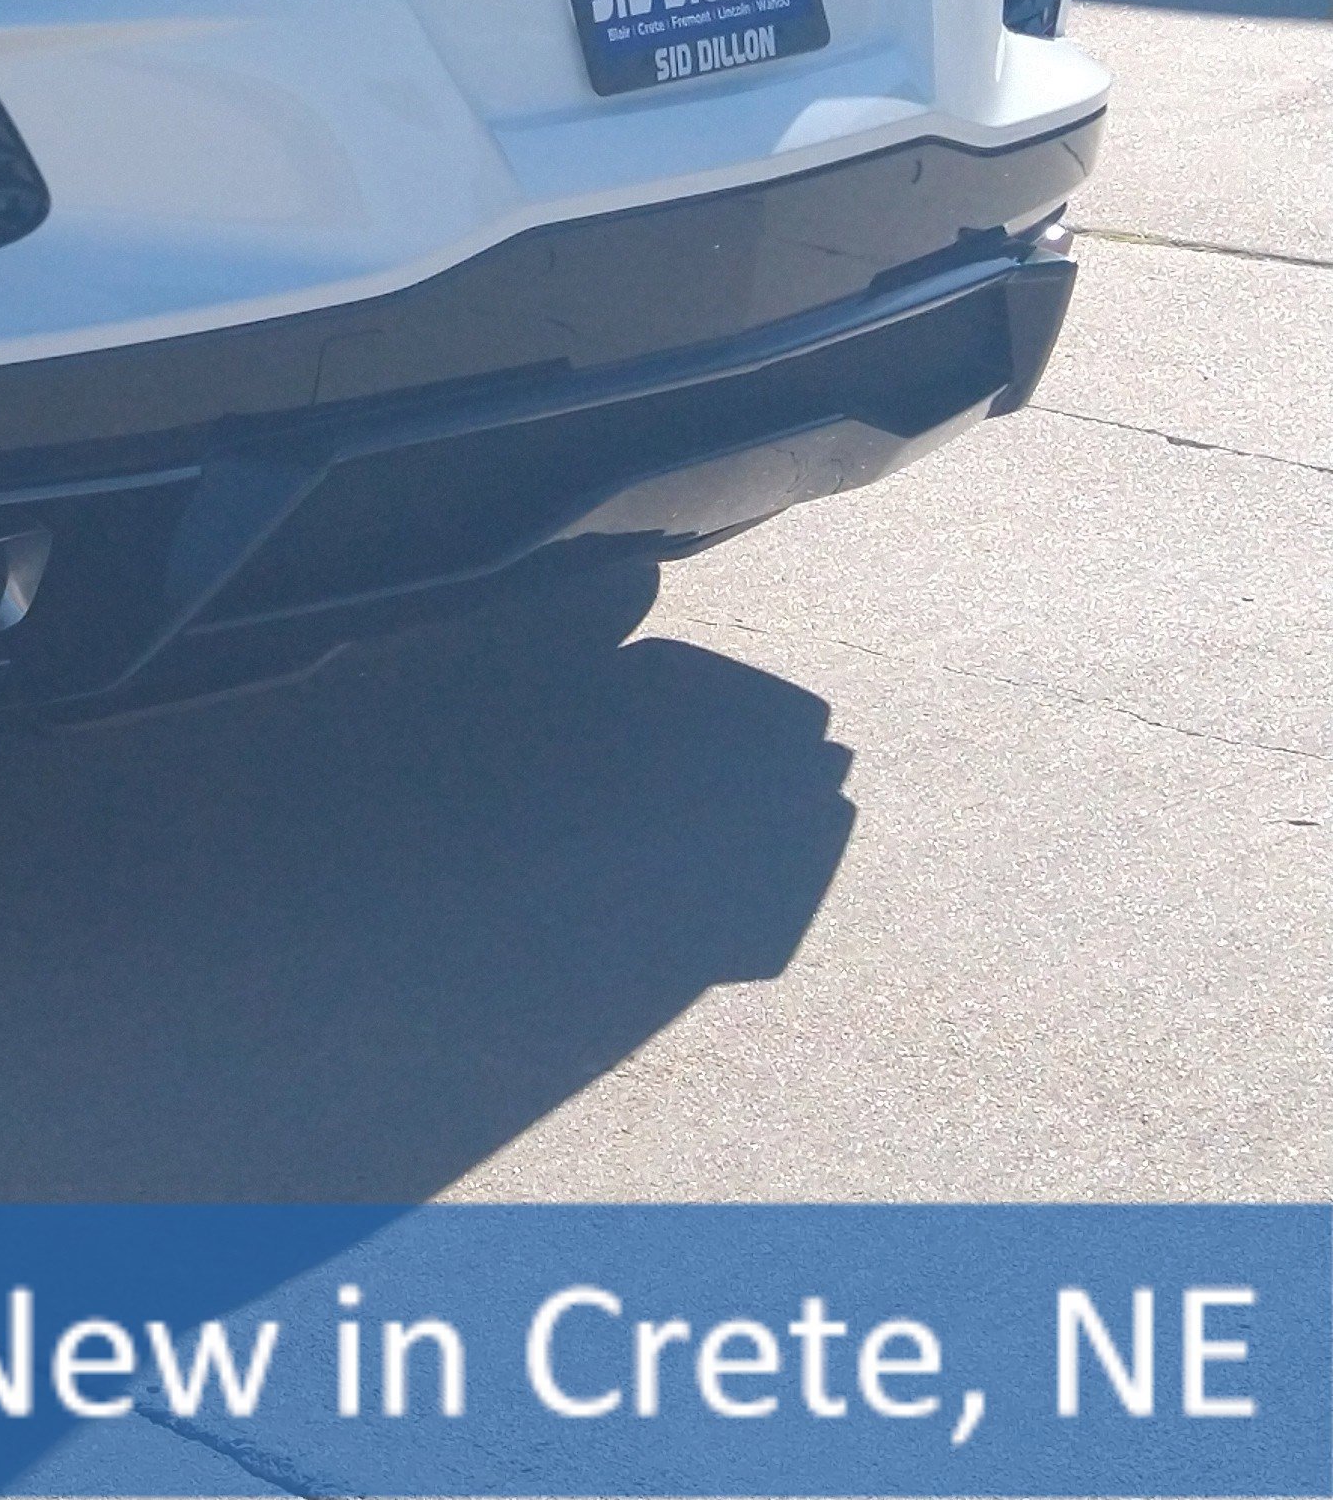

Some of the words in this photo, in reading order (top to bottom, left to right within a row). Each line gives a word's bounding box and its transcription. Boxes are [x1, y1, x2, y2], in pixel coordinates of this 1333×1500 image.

[637, 20, 666, 36] Crete
[671, 10, 712, 30] Fremont
[654, 42, 693, 82] SID
[697, 24, 777, 72] DILLON
